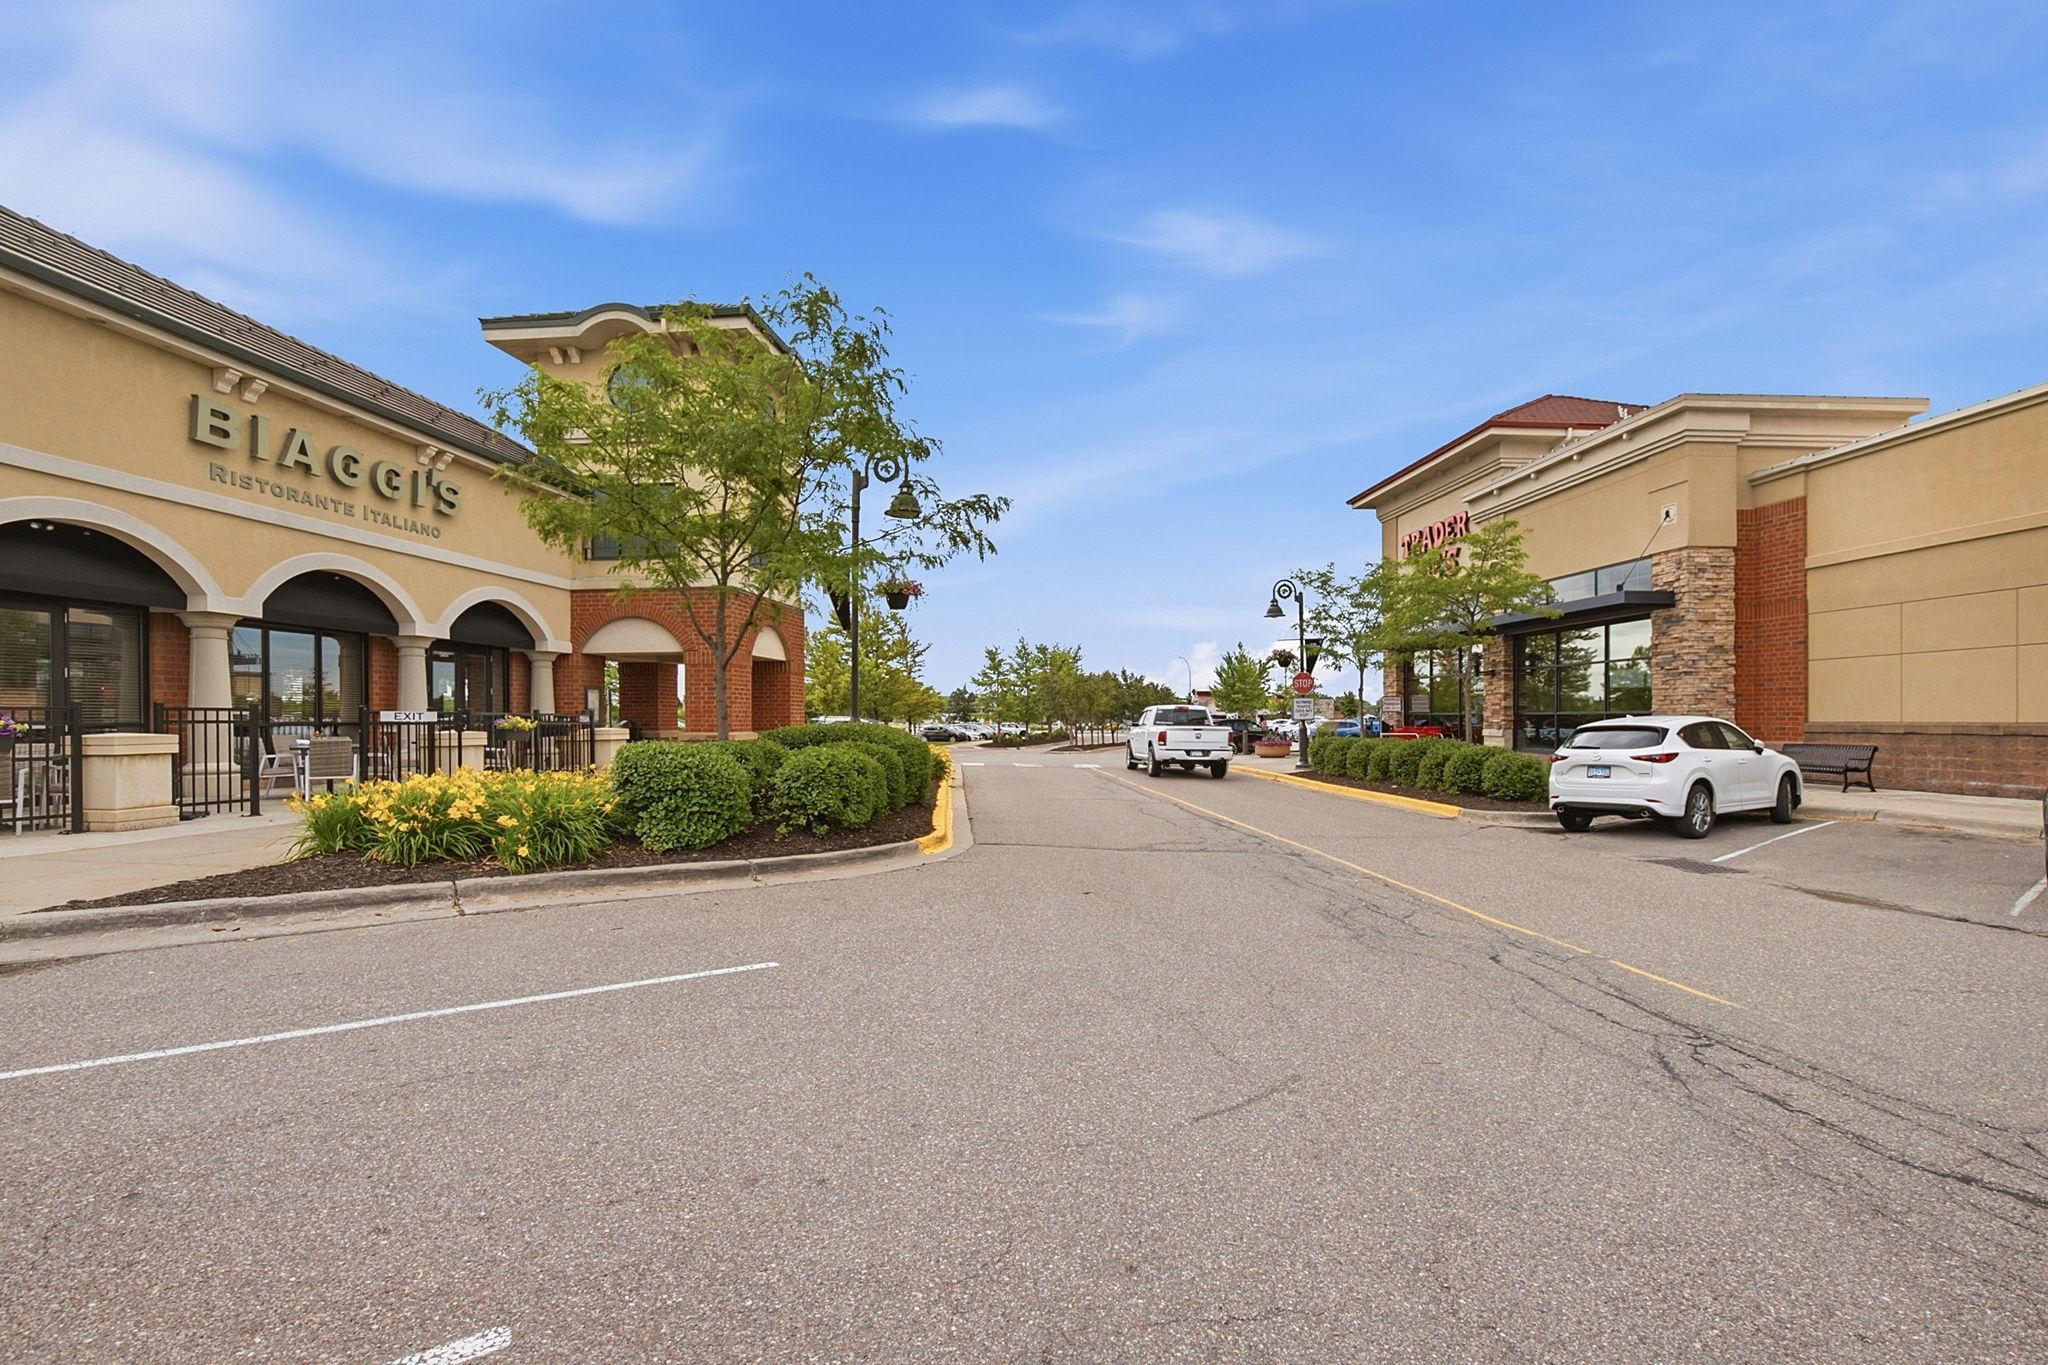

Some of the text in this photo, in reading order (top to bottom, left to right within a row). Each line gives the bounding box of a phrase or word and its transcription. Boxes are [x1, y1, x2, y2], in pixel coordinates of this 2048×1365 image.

[188, 394, 462, 517] BIAGGI'S
[209, 462, 441, 539] RISTORANTE ITALIANO
[1294, 679, 1313, 688] STOP
[394, 712, 424, 721] EXIT
